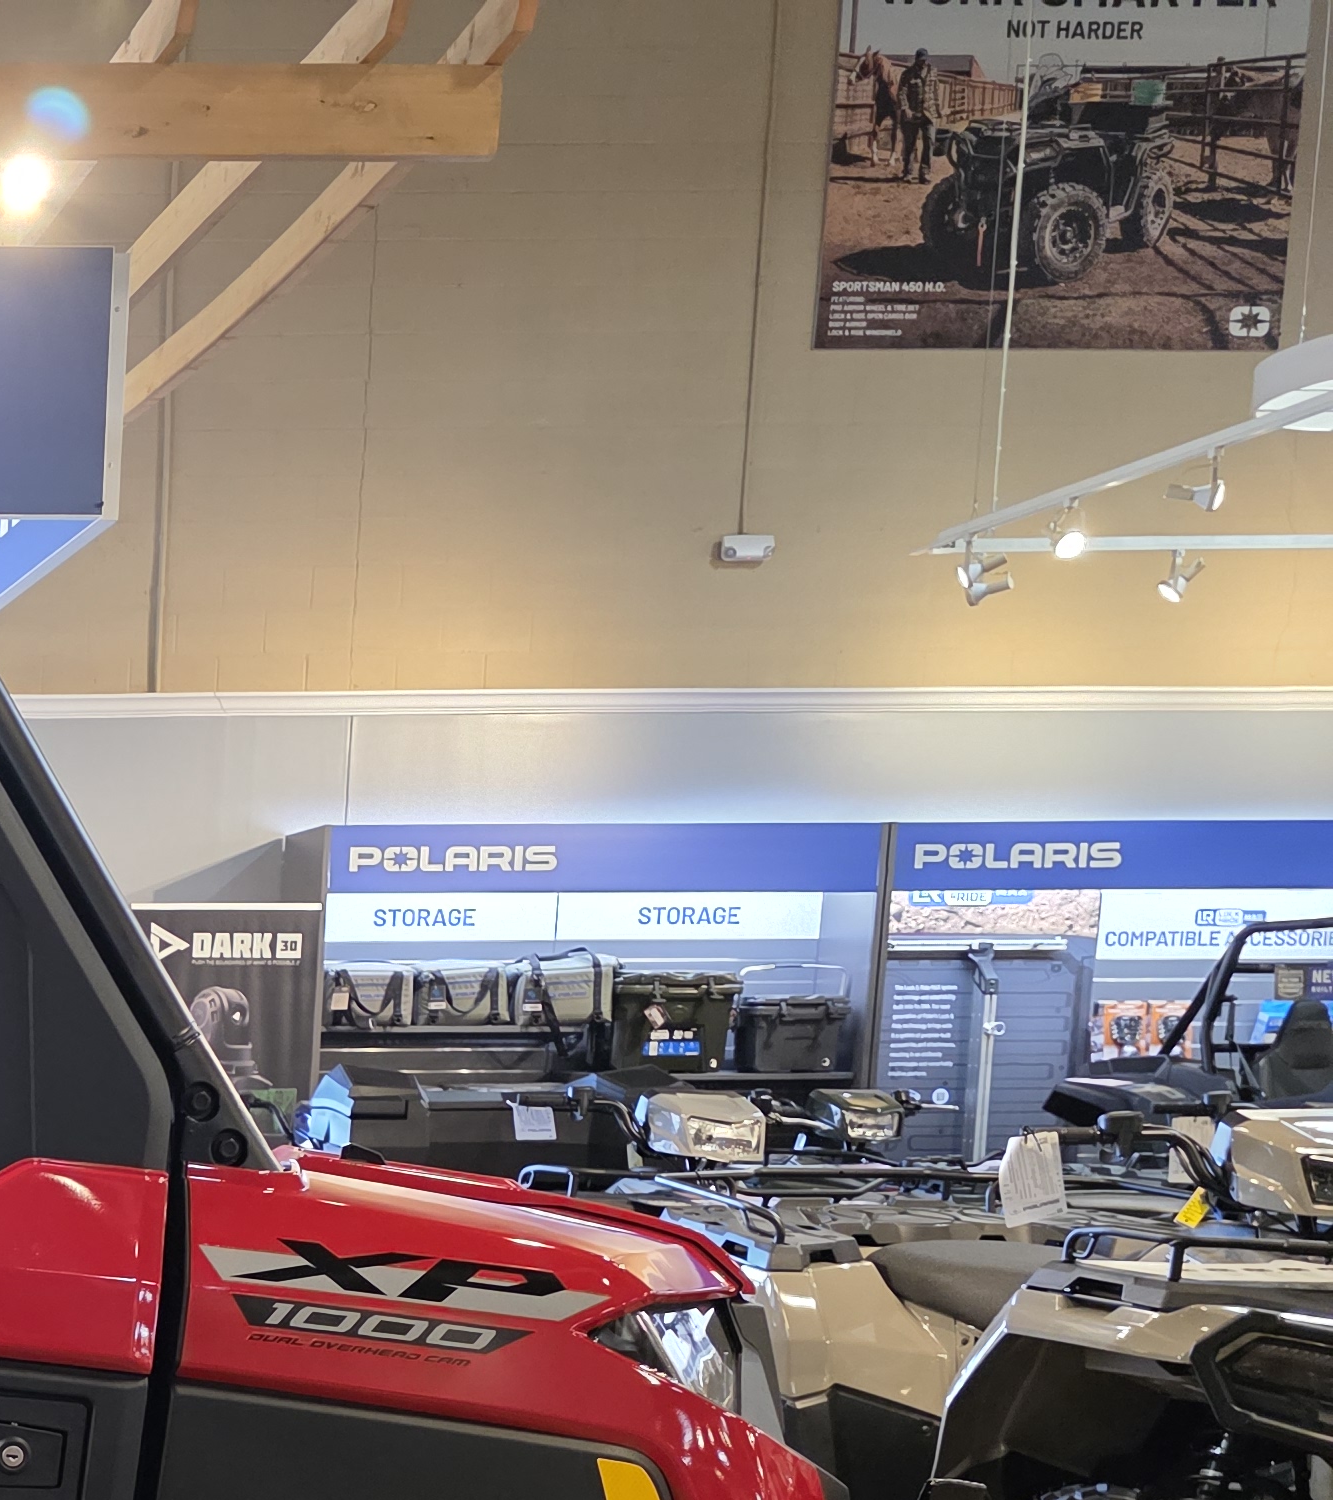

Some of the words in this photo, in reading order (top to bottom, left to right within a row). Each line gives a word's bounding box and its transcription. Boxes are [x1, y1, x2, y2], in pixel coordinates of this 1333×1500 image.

[1006, 20, 1050, 39] NOT
[1056, 20, 1144, 40] HARDER
[832, 281, 900, 292] SPORTSMAN
[902, 282, 923, 292] 450
[348, 845, 558, 872] POLARIS
[914, 841, 1123, 869] POLARIS
[373, 908, 476, 928] STORAGE
[637, 906, 741, 927] STORAGE
[192, 932, 273, 959] DARK
[280, 940, 297, 952] 30
[1105, 930, 1221, 947] COMPATIBLE
[1224, 930, 1333, 947] ACESSORIE
[230, 1238, 567, 1303] XP
[264, 1302, 496, 1351] 1000
[247, 1333, 304, 1347] DUAL
[310, 1338, 422, 1361] OVERHEAD
[424, 1355, 472, 1367] CAM
